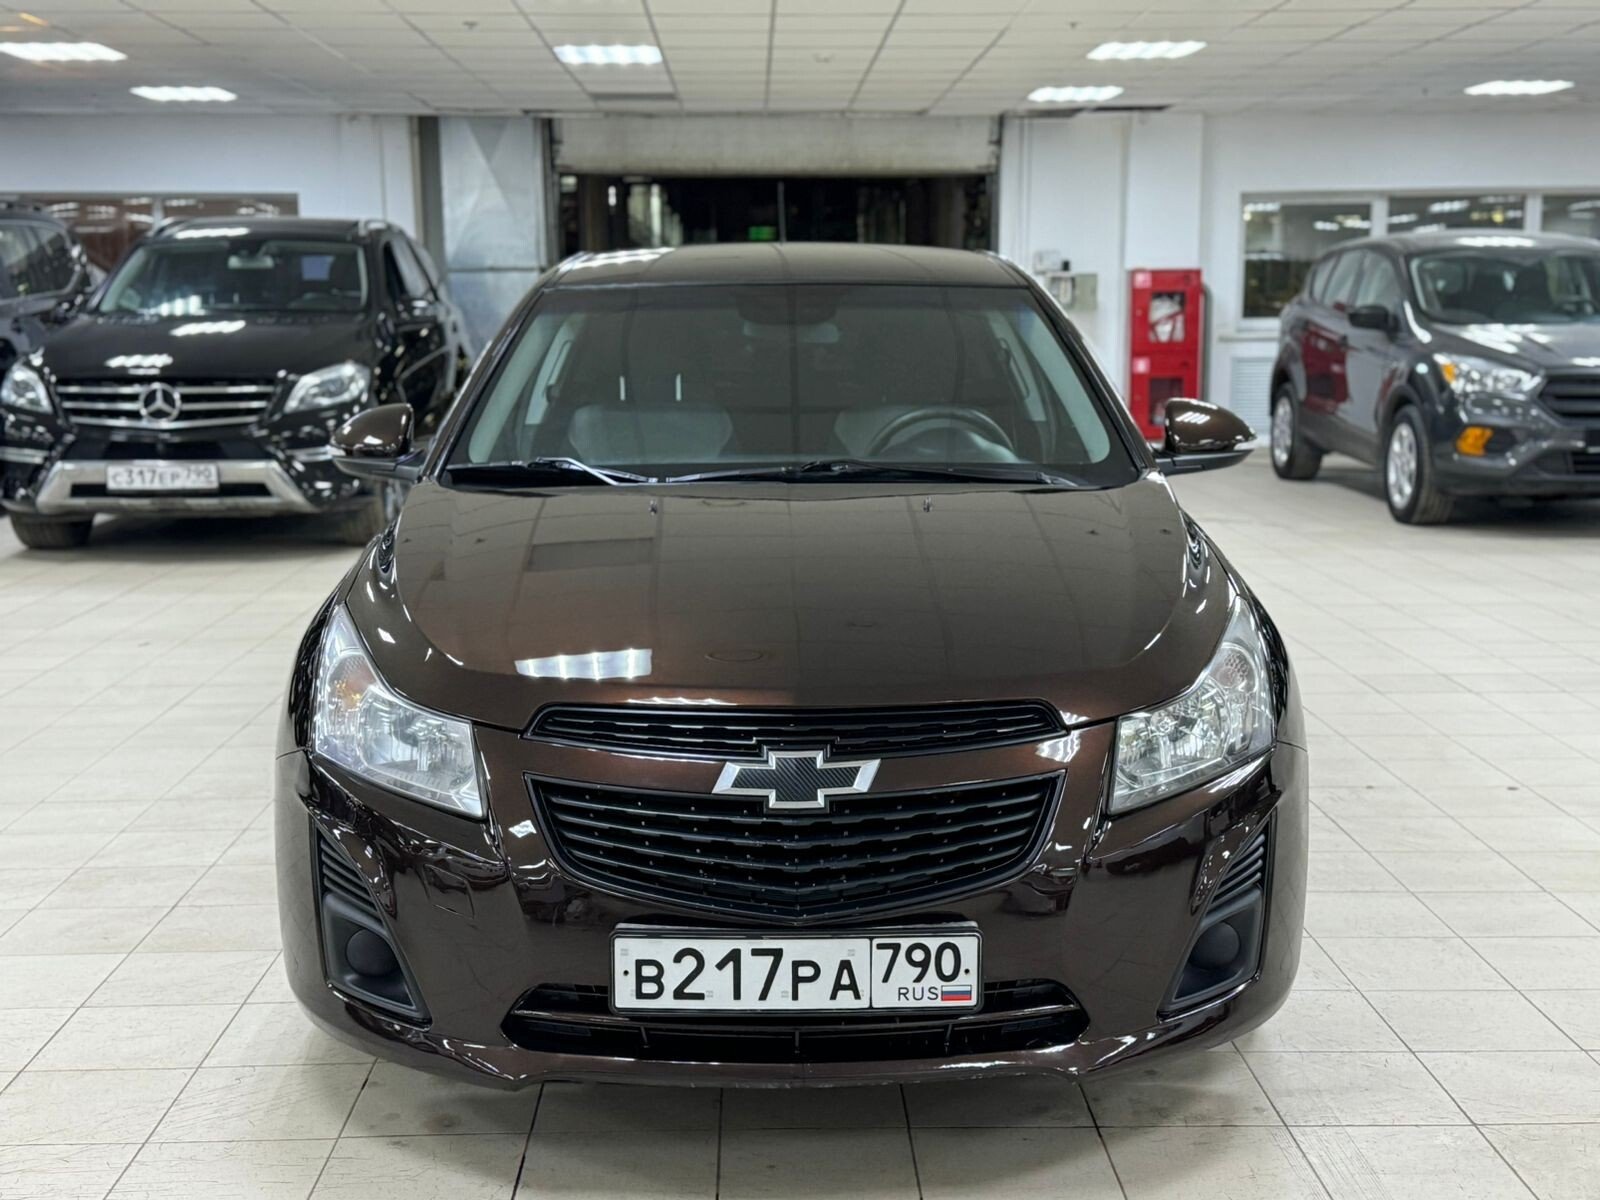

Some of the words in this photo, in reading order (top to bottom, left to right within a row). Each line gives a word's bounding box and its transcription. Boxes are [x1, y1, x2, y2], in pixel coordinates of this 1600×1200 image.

[634, 947, 862, 1001] В217РА
[876, 941, 962, 984] 790
[897, 986, 939, 1001] RUS
